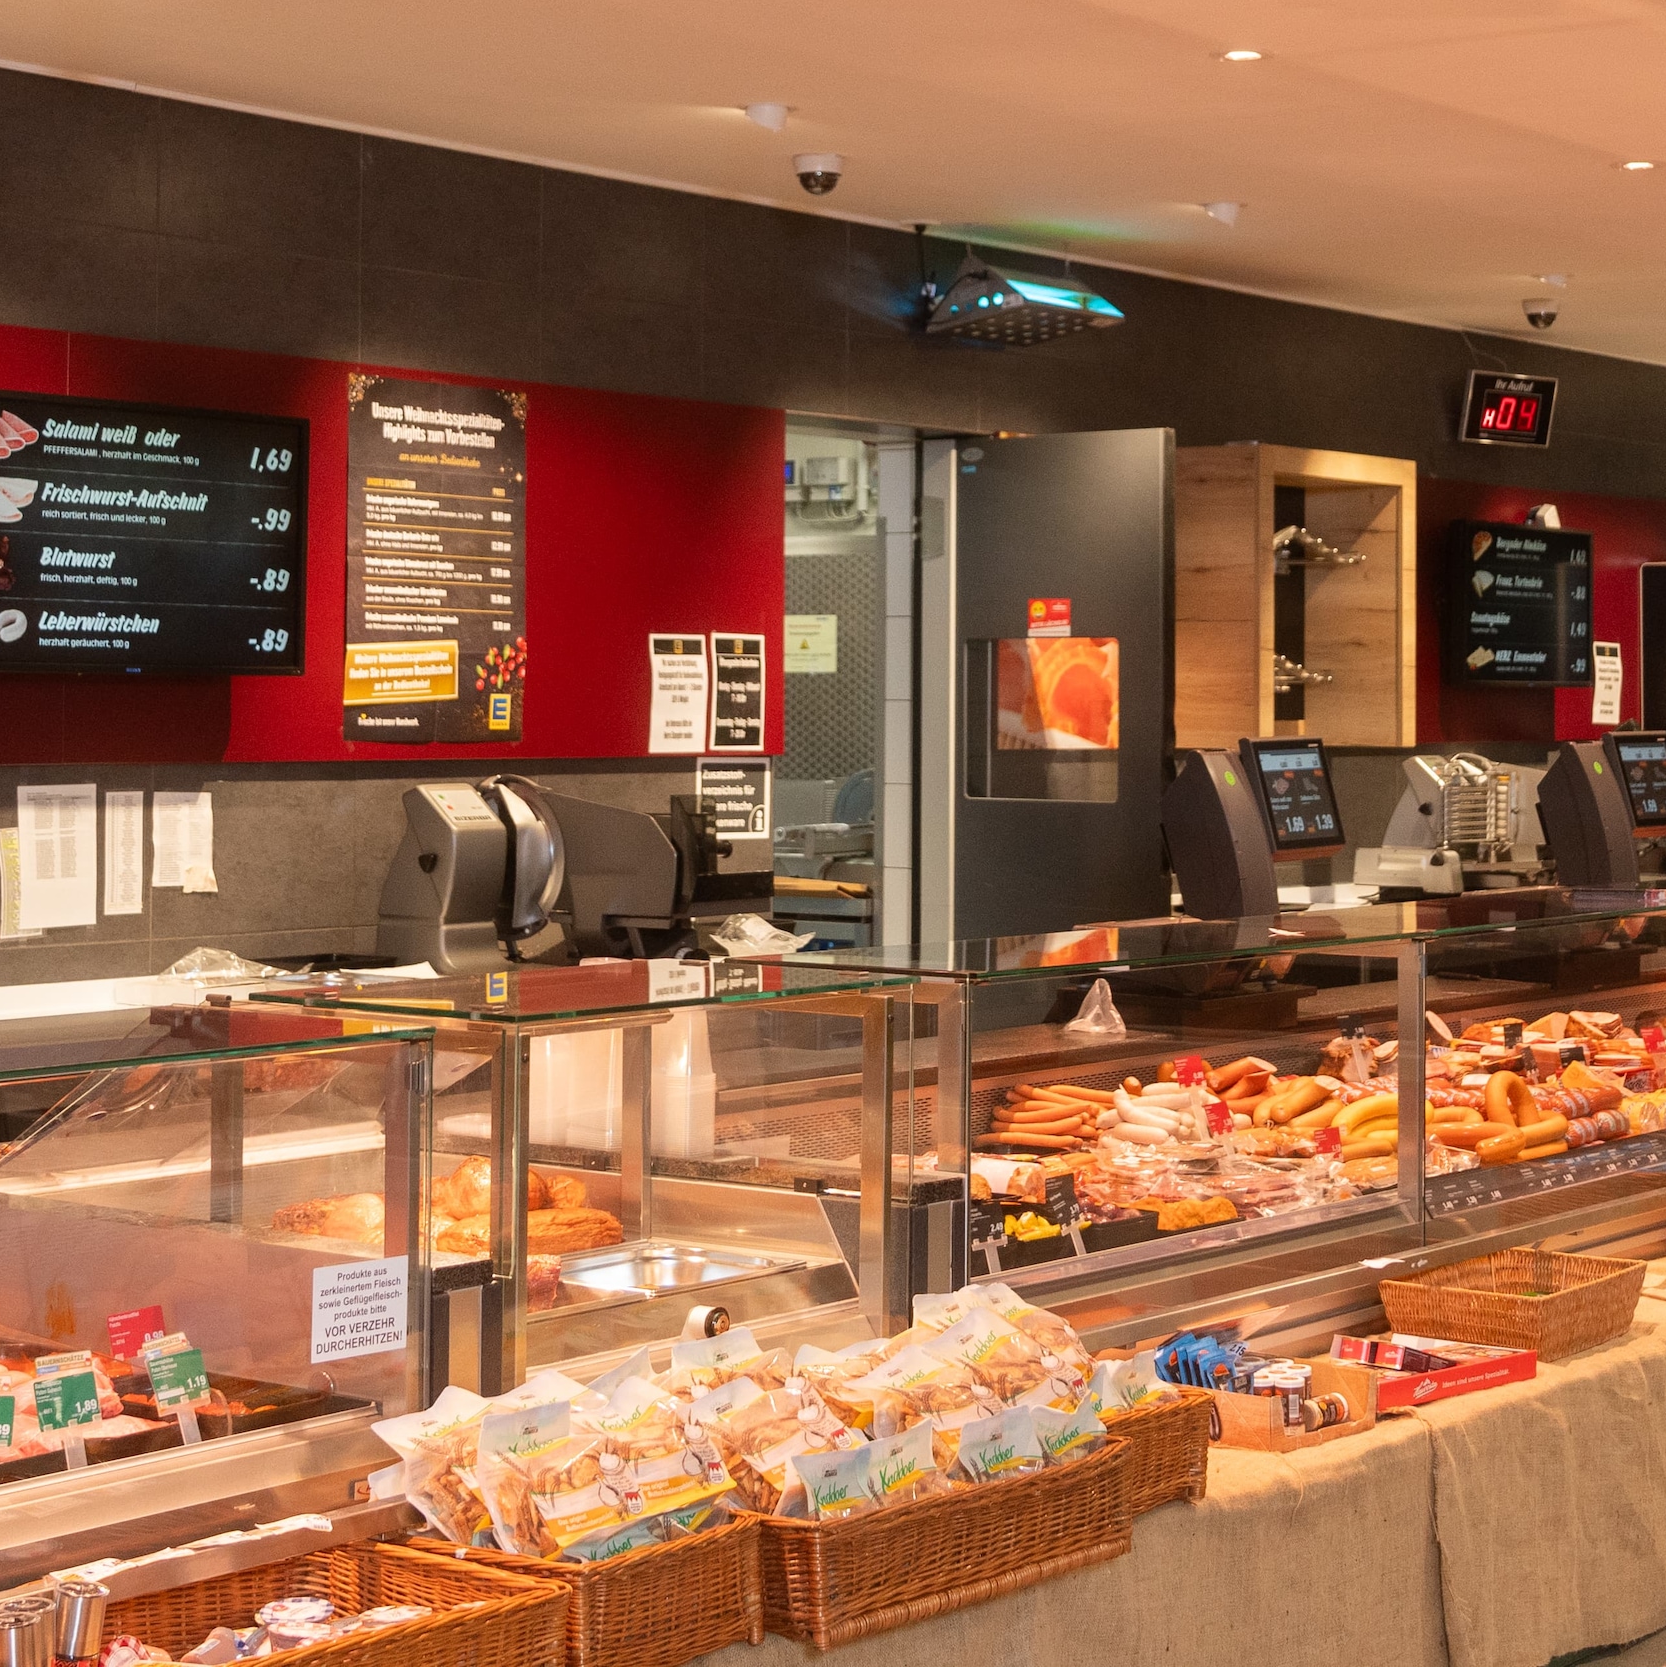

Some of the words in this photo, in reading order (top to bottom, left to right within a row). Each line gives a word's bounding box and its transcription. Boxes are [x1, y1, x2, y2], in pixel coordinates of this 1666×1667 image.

[1495, 379, 1507, 389] Ihr
[1508, 380, 1533, 391] Aufruf
[372, 402, 402, 421] Unsere
[404, 405, 505, 432] Weihnachtsspezialitäten-
[42, 418, 99, 441] Salami
[101, 425, 137, 445] weiß
[145, 428, 180, 448] oder
[383, 422, 426, 444] Highlights
[427, 430, 444, 443] zum
[446, 428, 495, 449] Vorbestellen
[44, 445, 97, 457] PFEFFERSALAMI
[103, 450, 131, 460] herzhaft
[133, 452, 141, 461] im
[183, 457, 194, 465] 100
[250, 447, 293, 473] 1,69
[41, 482, 208, 511] Frischwurst-Aufschnit
[42, 509, 60, 518] reich
[61, 510, 88, 520] sortiert,
[90, 512, 109, 521] frisch
[111, 513, 124, 522] und
[150, 516, 160, 524] 100
[251, 508, 291, 533] -.99
[40, 547, 116, 569] Blutwurst
[41, 573, 62, 583] frisch,
[121, 577, 131, 585] 100
[250, 569, 290, 592] -.89
[38, 611, 160, 633] Leberwürstchen
[39, 637, 69, 646] herzhaft
[71, 639, 111, 649] geräuchert,
[113, 639, 123, 648] 100
[248, 629, 289, 652] -.89
[338, 1269, 371, 1281] Produkte
[374, 1267, 387, 1276] aus
[321, 1282, 372, 1297] zerkleinertem
[374, 1277, 401, 1289] Fleisch
[319, 1299, 341, 1310] sowie
[343, 1289, 403, 1307] Geflügelfleisch-
[334, 1307, 368, 1322] produkte
[371, 1304, 386, 1314] bitte
[325, 1325, 346, 1338] VOR
[349, 1317, 395, 1334] VERZEHR
[316, 1331, 403, 1354] DURCHERHITZEN!
[187, 1375, 206, 1388] 1.19
[1457, 1377, 1467, 1385] sind
[1468, 1375, 1484, 1383] unsere
